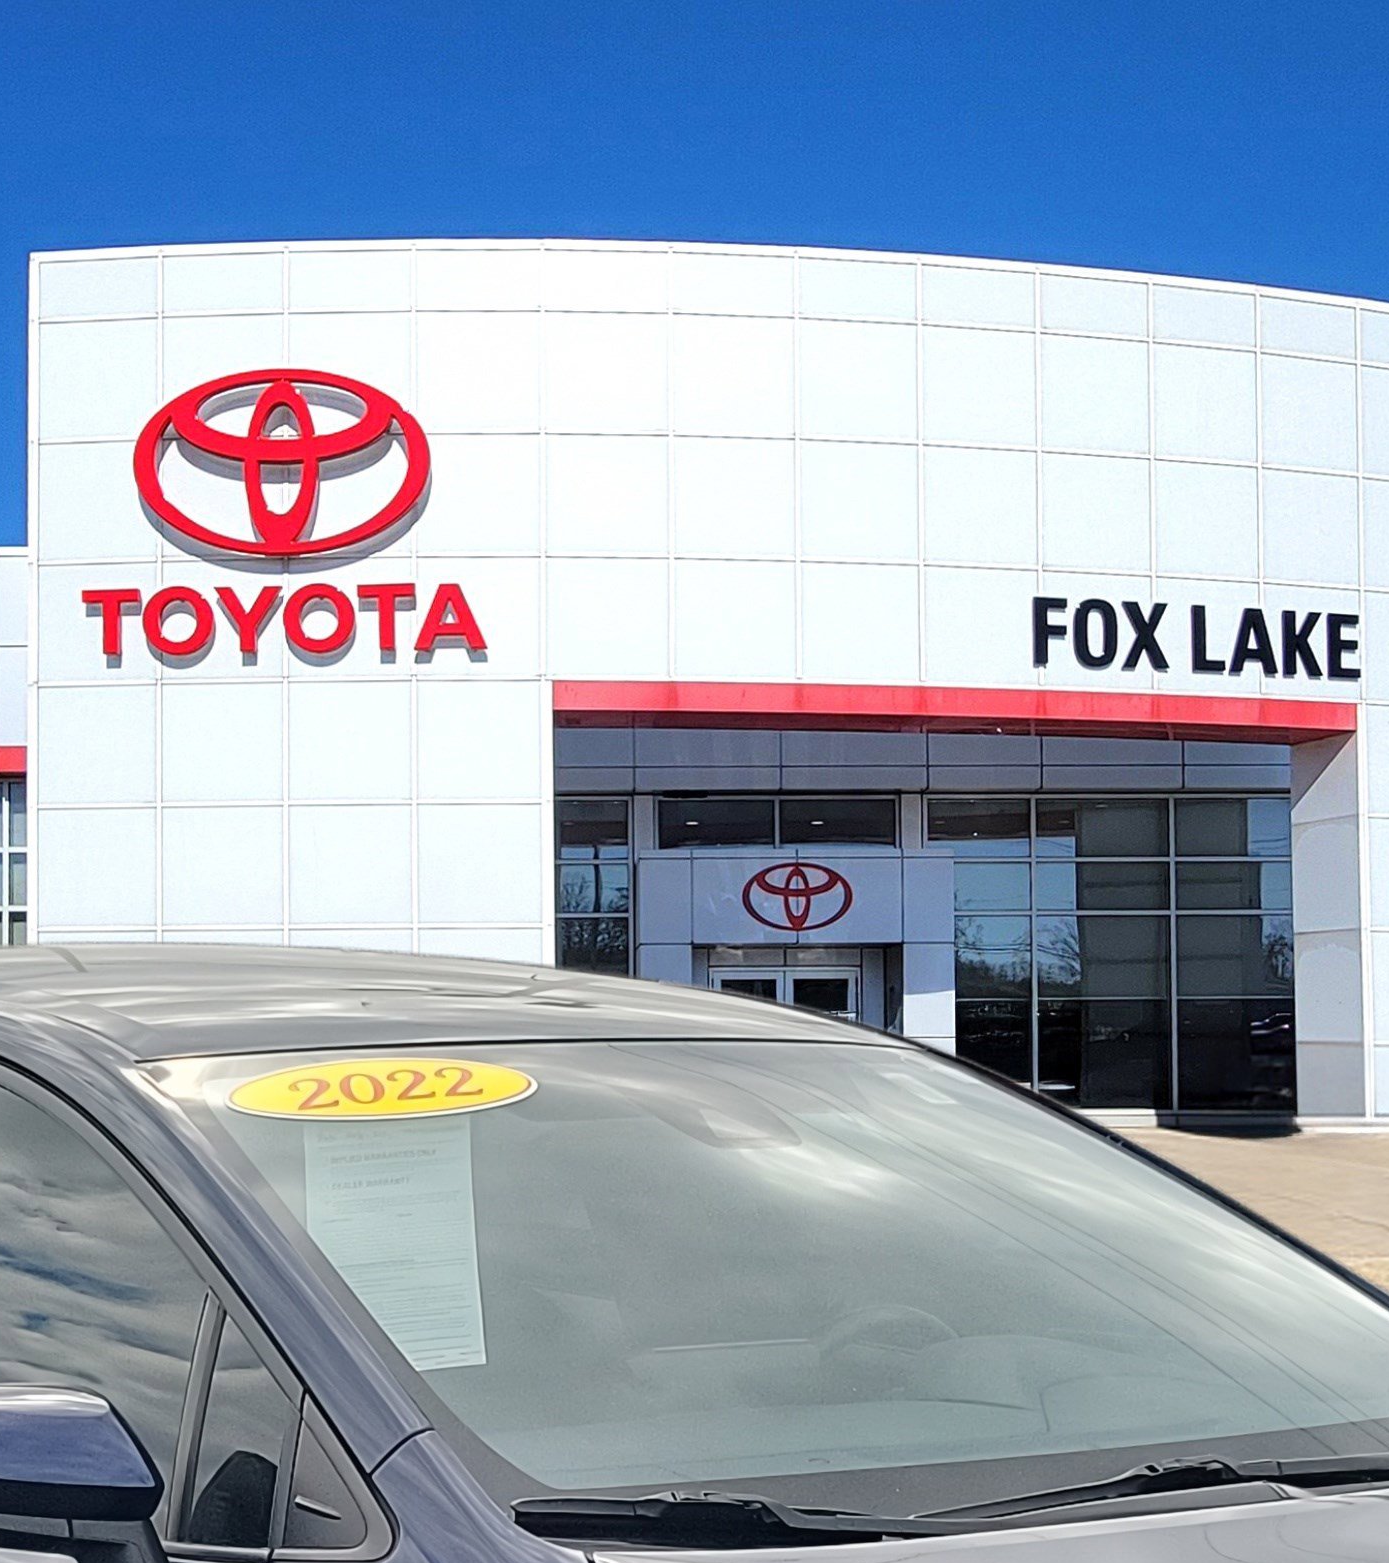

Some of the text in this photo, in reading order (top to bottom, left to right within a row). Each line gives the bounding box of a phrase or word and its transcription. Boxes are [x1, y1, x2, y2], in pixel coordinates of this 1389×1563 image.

[82, 583, 488, 660] TOYOTA
[1032, 596, 1362, 679] FOX LAKE
[288, 1066, 484, 1111] 2022
